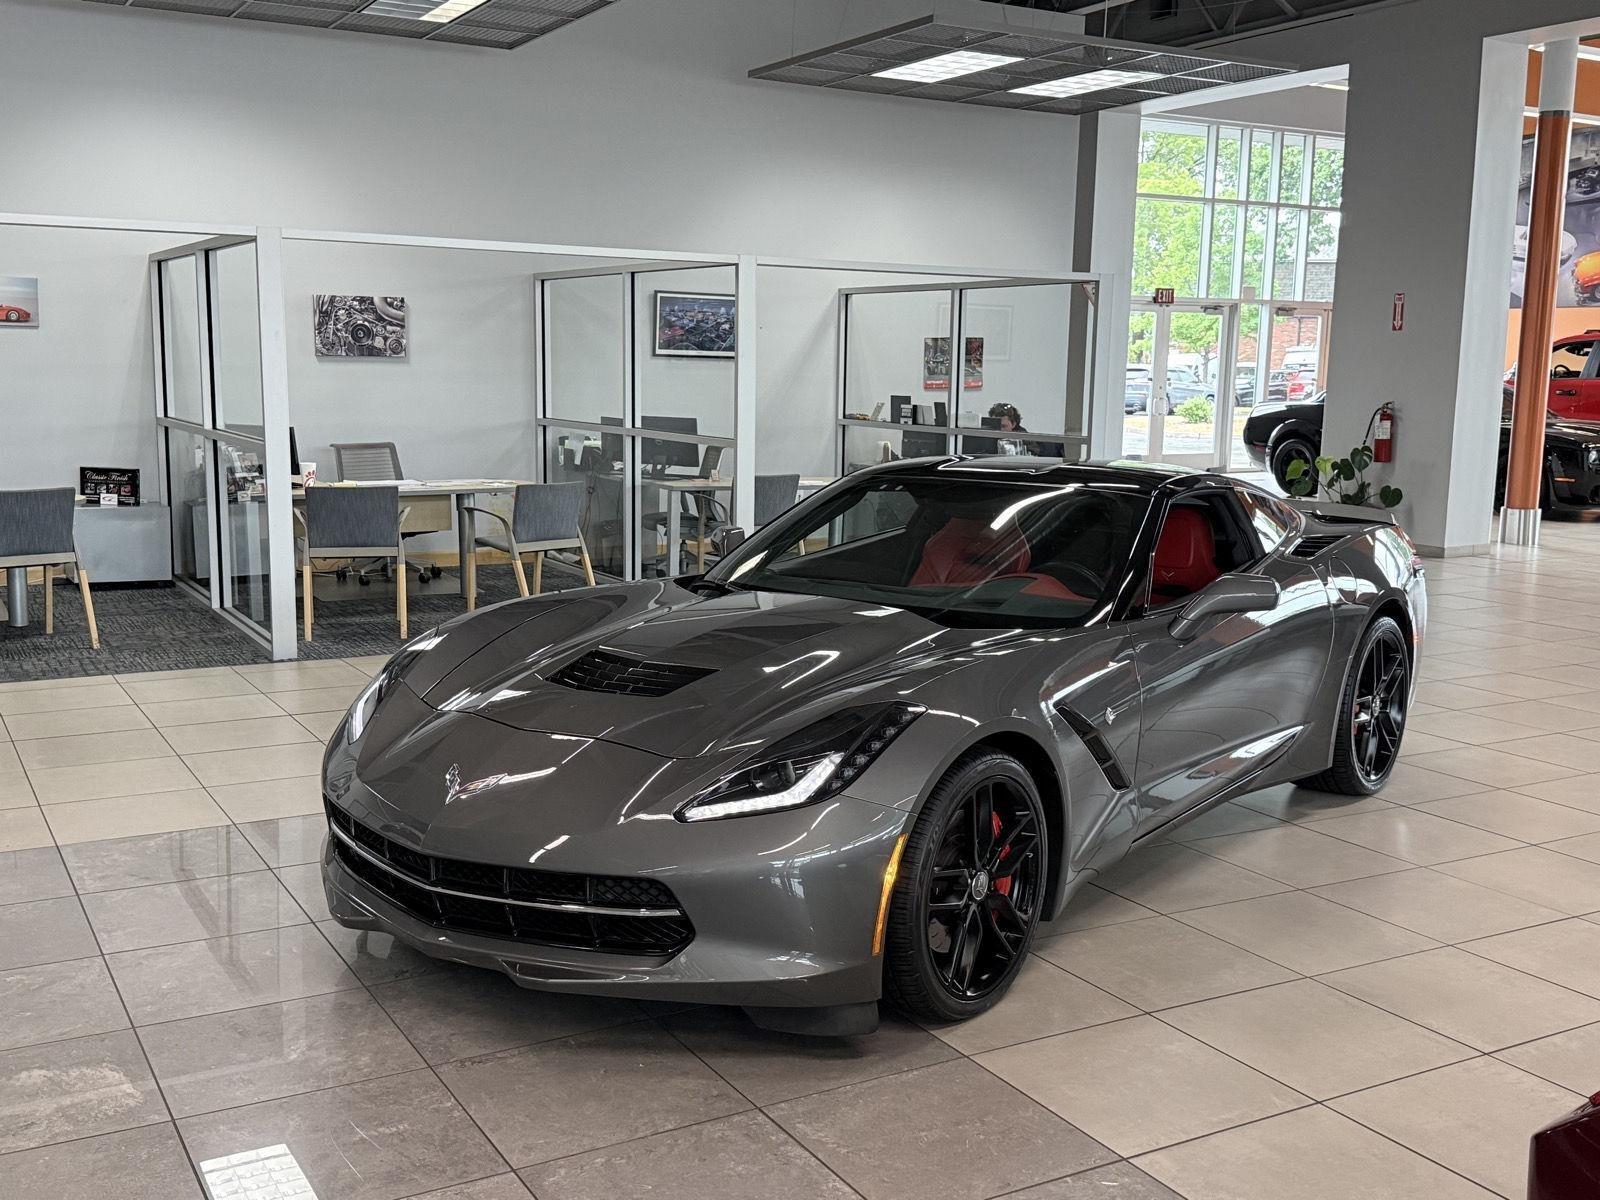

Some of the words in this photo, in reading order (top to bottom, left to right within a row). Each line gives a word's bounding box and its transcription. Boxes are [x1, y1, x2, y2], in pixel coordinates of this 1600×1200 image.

[1158, 289, 1173, 302] EXIT
[85, 470, 107, 480] Classic
[108, 472, 129, 481] Finish
